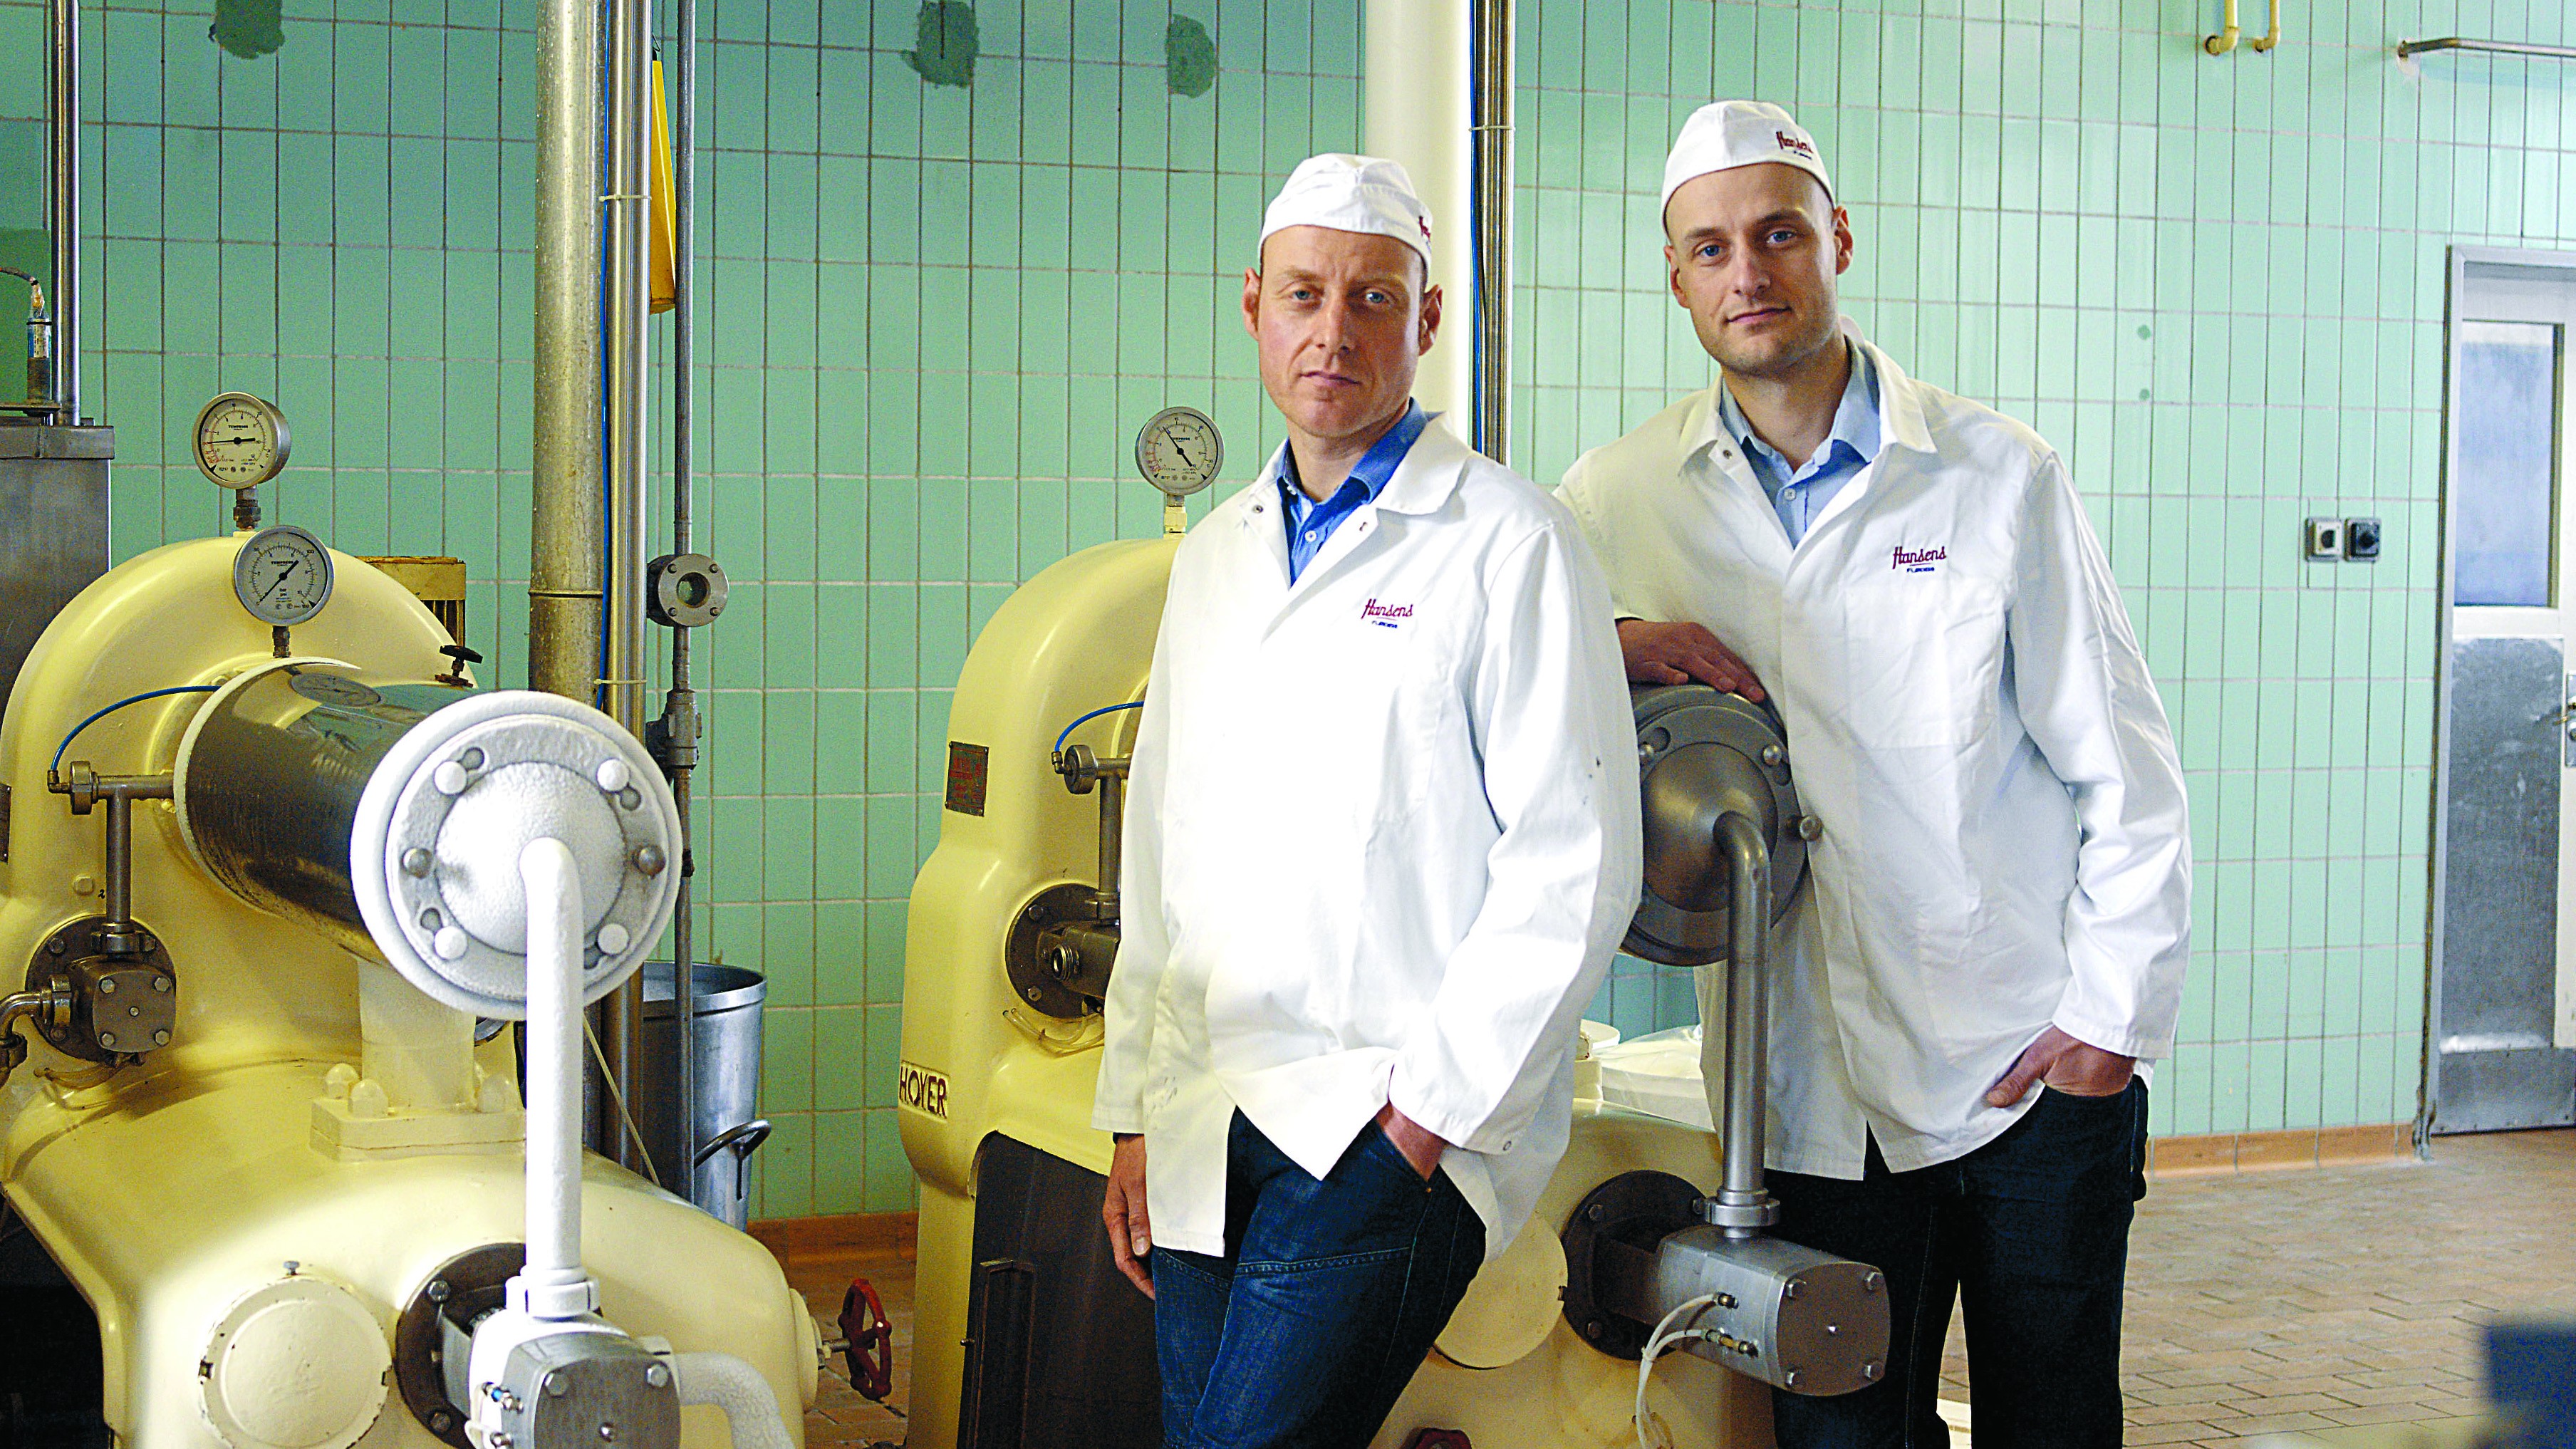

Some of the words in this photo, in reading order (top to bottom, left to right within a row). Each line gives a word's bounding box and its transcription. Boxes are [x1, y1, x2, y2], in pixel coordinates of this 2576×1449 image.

[1892, 546, 1947, 569] Hansens
[1361, 598, 1413, 620] Hansens
[899, 1066, 947, 1119] HOYER
